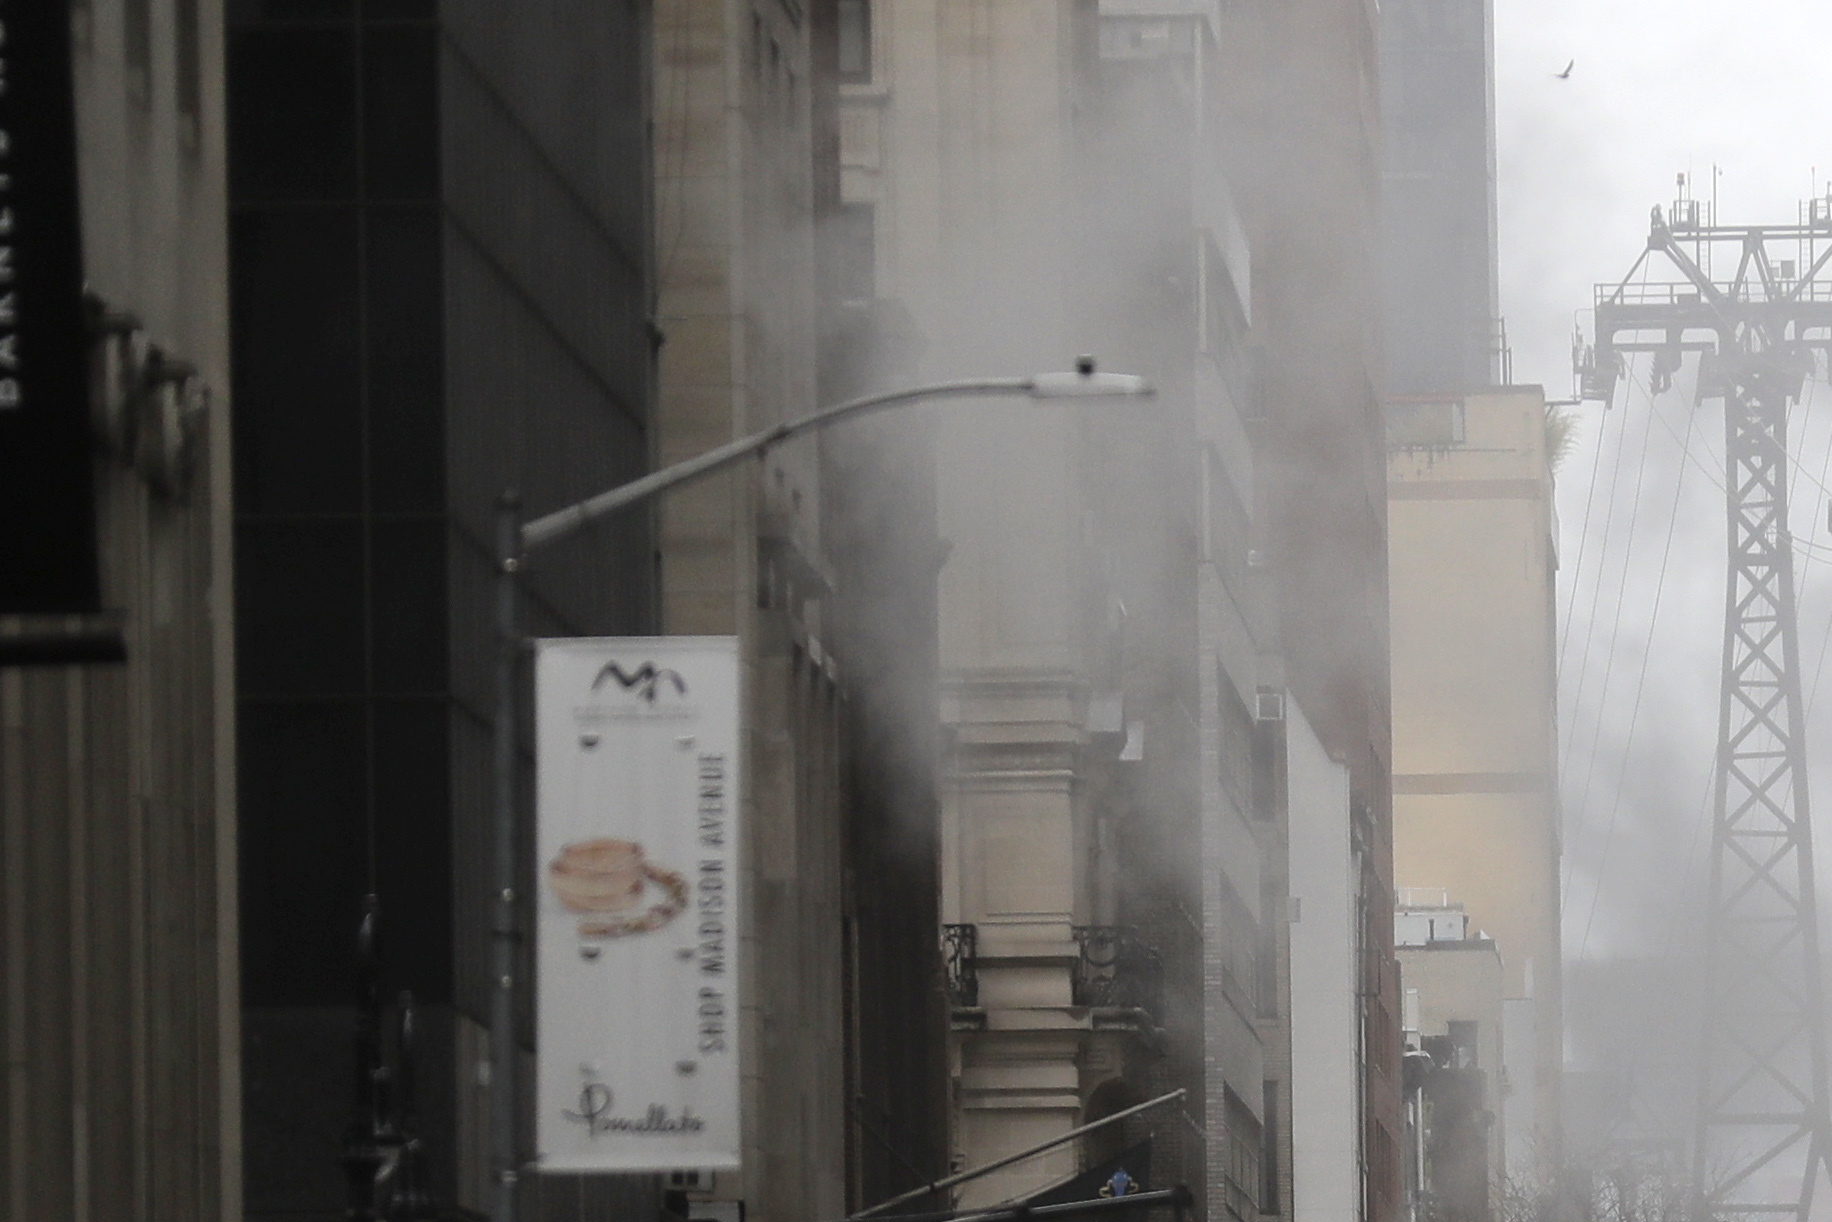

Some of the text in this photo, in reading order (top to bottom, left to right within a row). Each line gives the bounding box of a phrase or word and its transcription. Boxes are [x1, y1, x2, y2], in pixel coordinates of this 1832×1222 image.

[701, 754, 728, 1053] SHOP MADISON AVENUE
